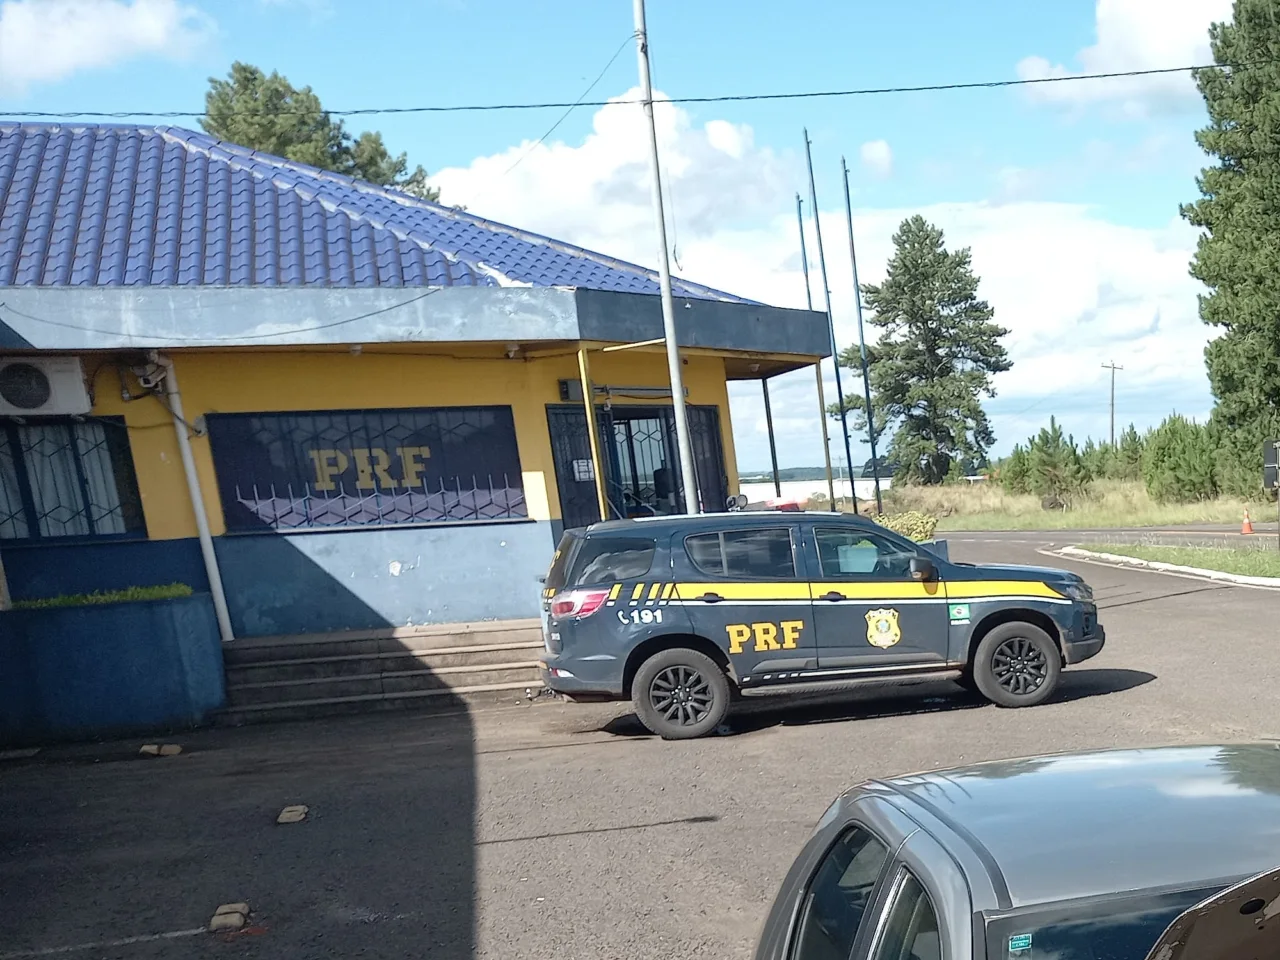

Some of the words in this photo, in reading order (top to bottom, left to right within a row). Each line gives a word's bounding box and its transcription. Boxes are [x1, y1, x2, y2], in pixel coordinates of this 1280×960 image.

[309, 446, 430, 490] PRF
[630, 609, 663, 624] 191
[725, 620, 804, 654] PRF
